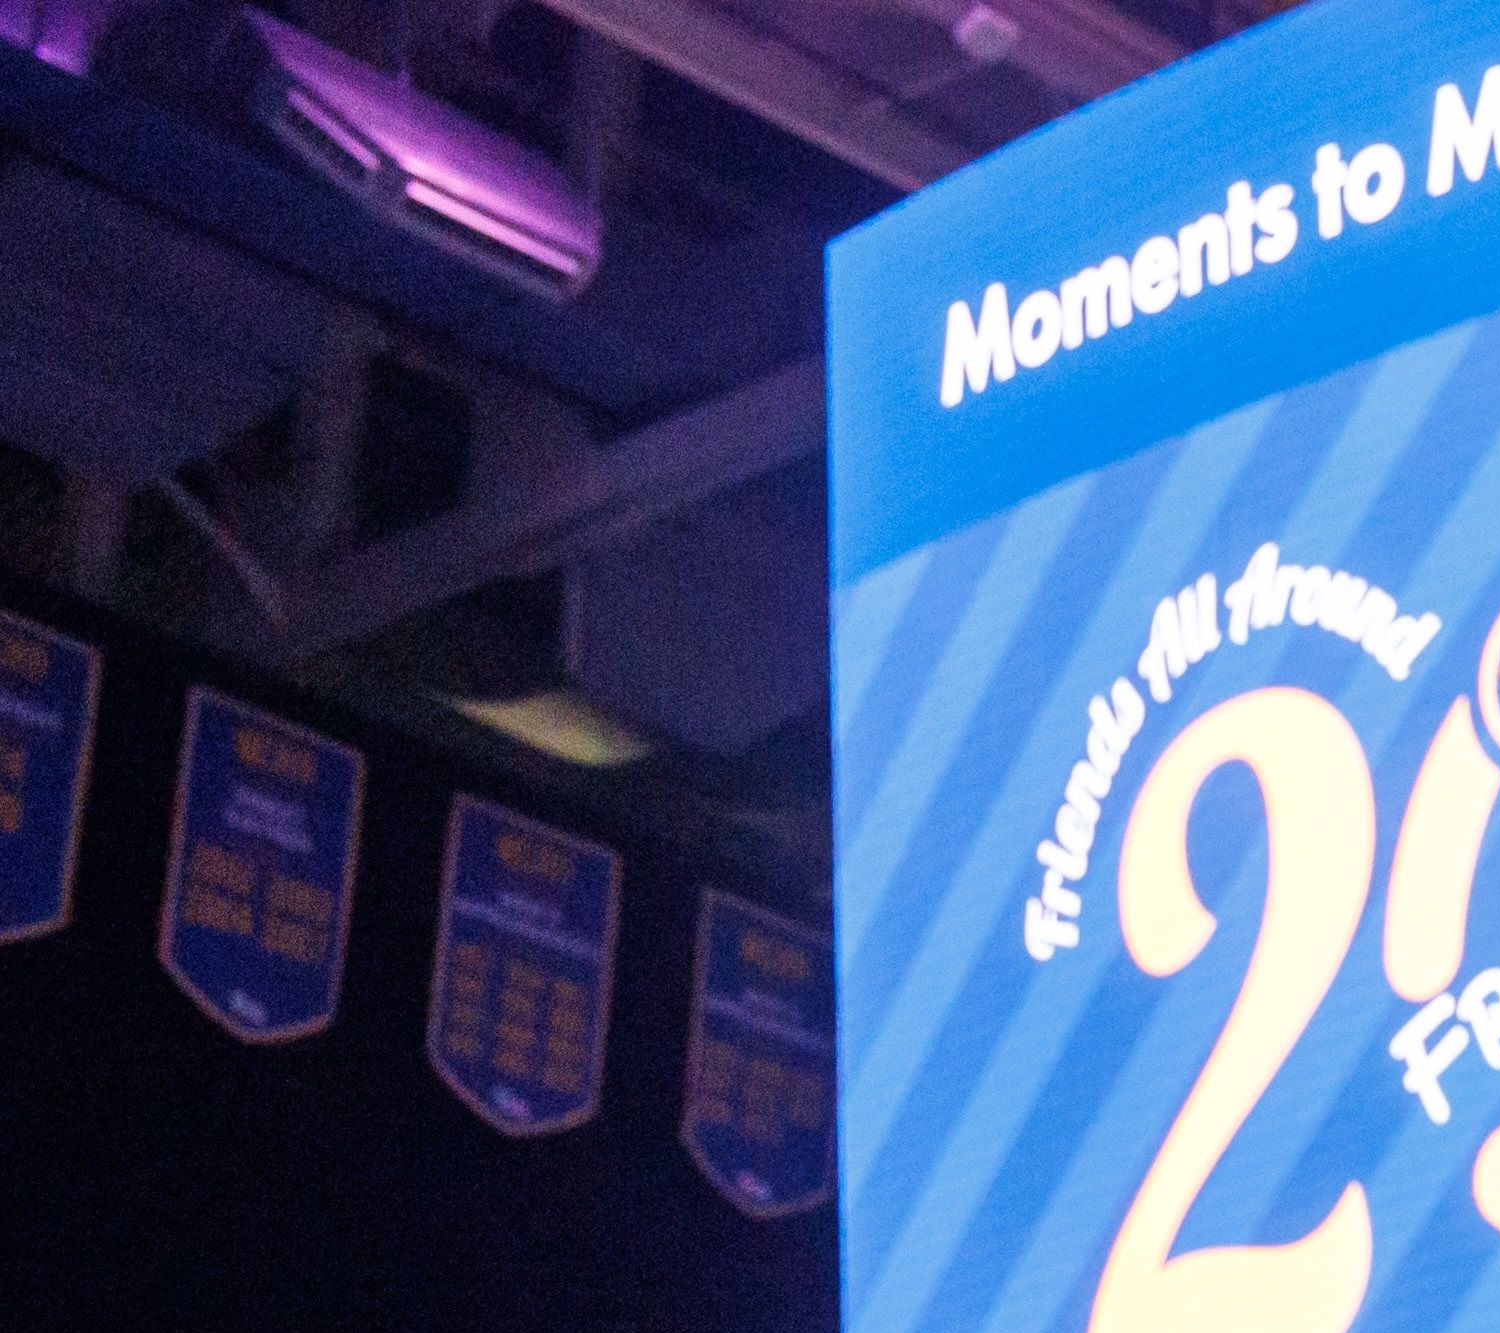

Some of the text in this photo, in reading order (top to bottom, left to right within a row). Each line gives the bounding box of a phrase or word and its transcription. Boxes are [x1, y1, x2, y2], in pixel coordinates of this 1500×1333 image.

[941, 181, 1299, 408] Moments
[1313, 143, 1403, 239] to
[1024, 542, 1441, 961] Friends All Around
